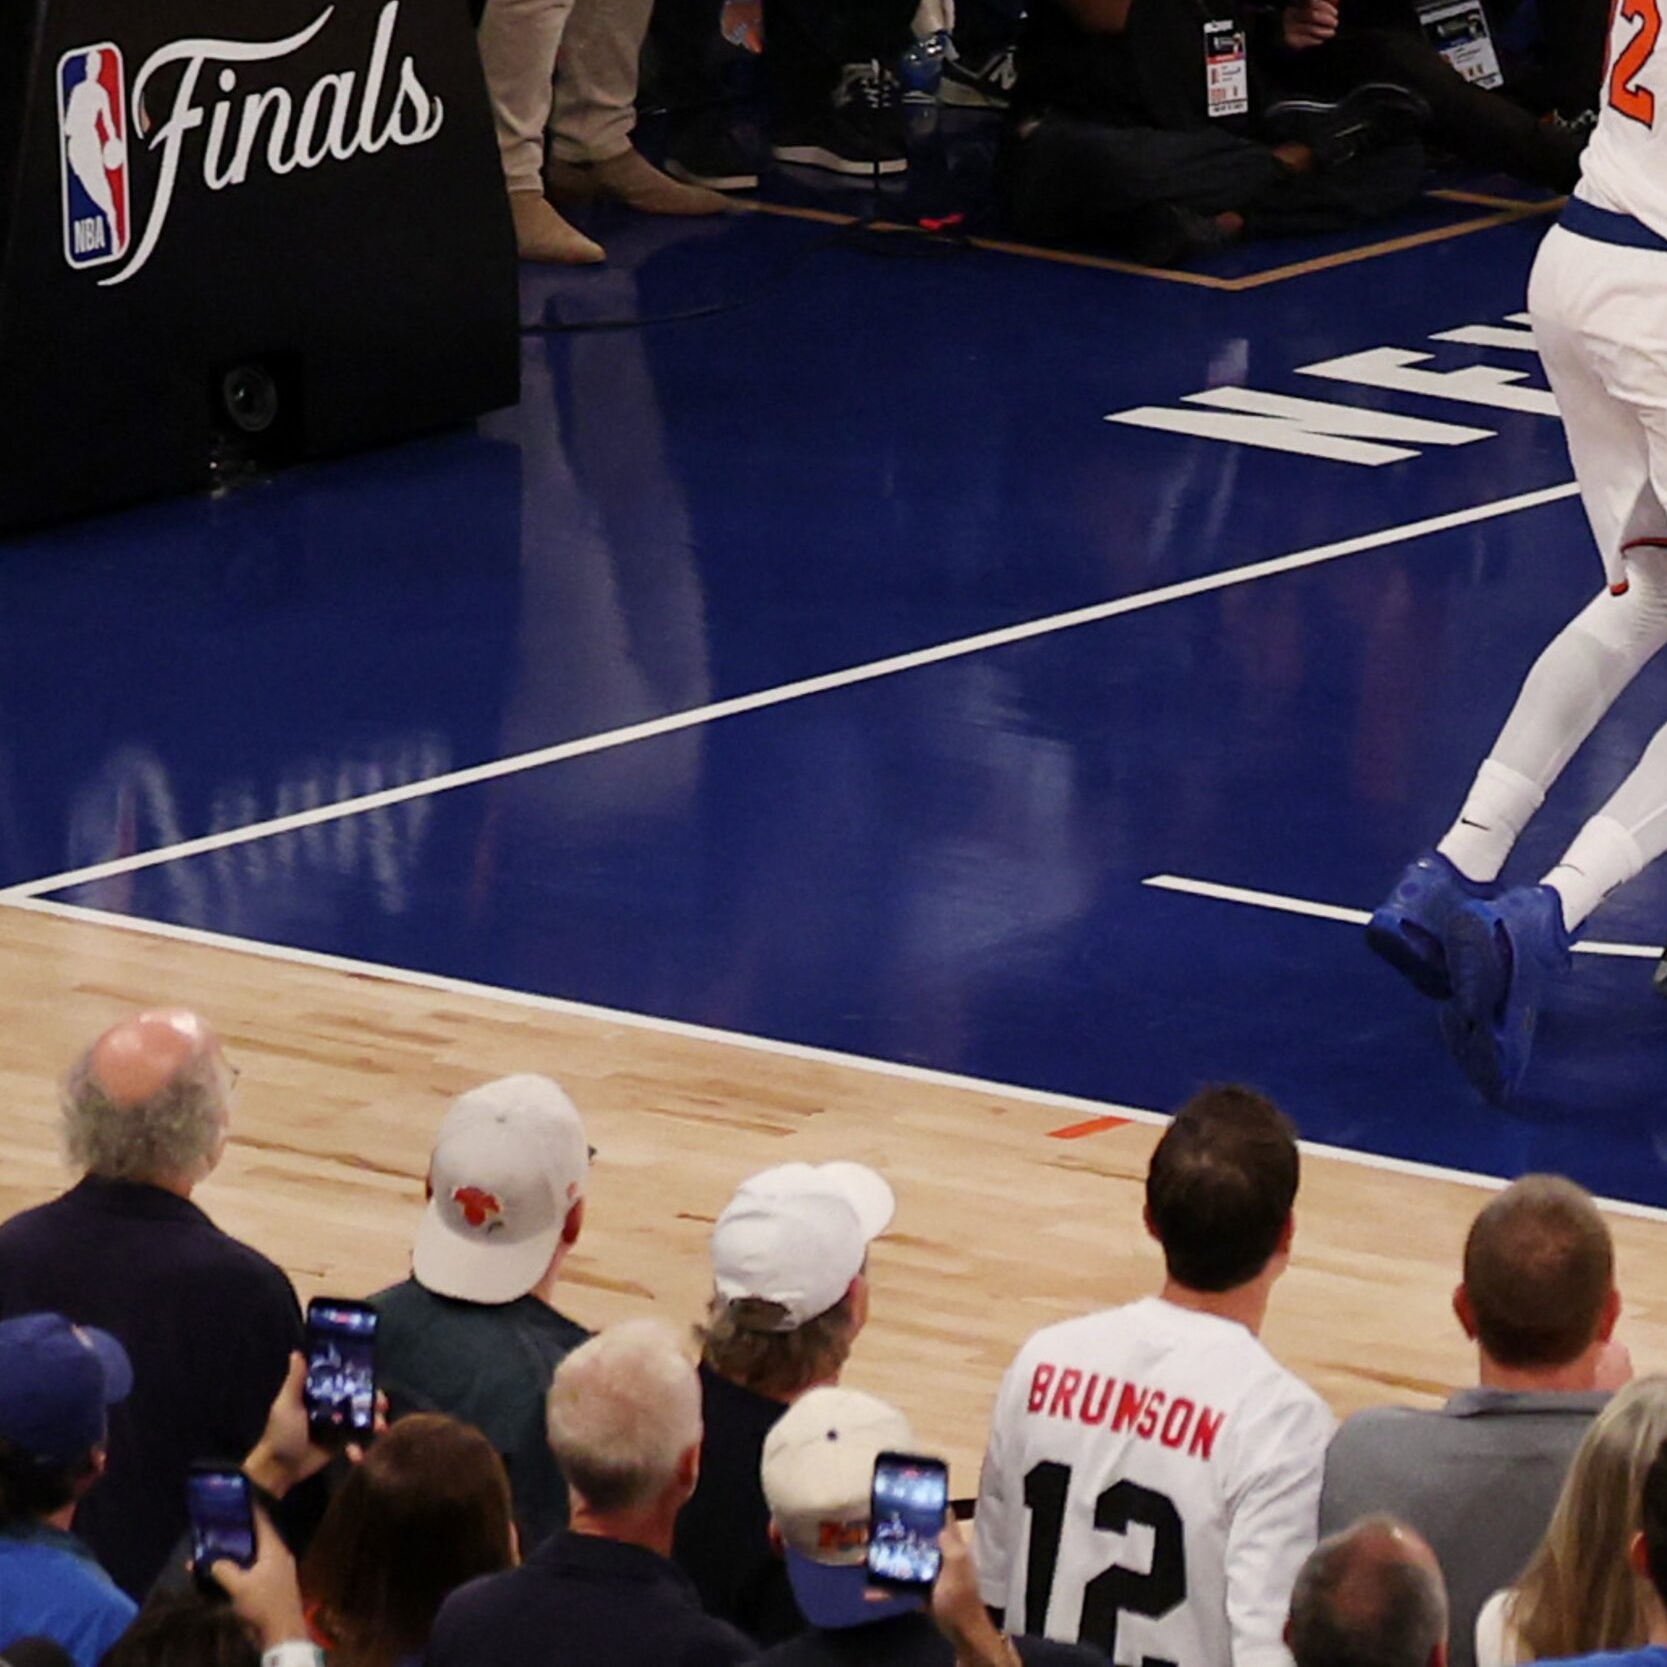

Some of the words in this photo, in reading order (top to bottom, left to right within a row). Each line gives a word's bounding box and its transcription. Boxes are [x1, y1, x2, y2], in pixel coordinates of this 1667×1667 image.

[74, 215, 106, 254] NBA
[1028, 1362, 1225, 1461] BRUNSON
[1023, 1459, 1188, 1667] 12
